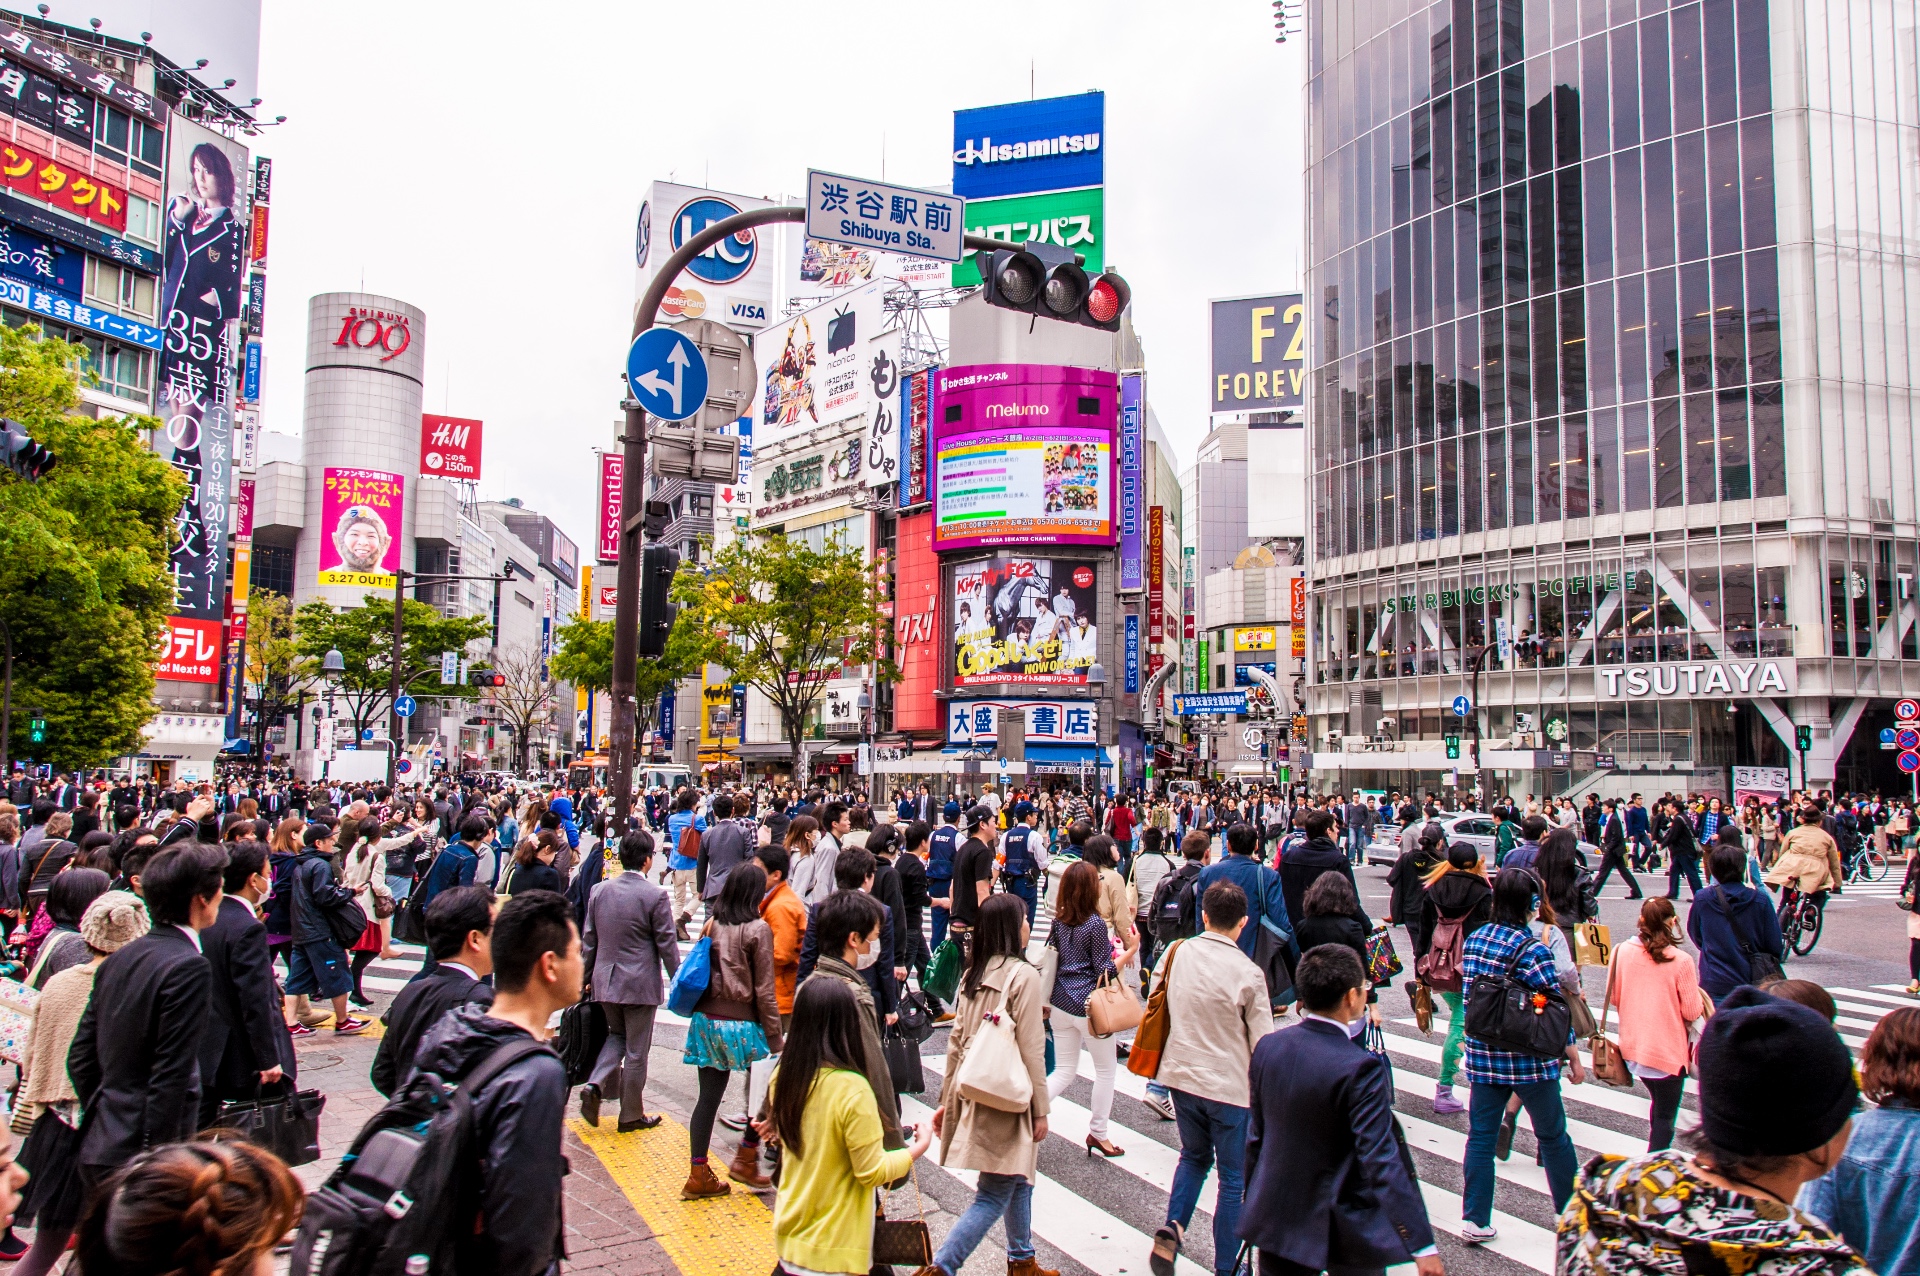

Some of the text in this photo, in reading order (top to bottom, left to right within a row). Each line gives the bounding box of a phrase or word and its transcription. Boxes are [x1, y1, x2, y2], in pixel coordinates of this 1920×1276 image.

[952, 132, 1100, 166] Hisamitsu
[2, 147, 121, 215] ンタクト
[820, 182, 952, 233] 渋谷駅前
[58, 226, 84, 238] JAPANESE
[86, 235, 106, 246] DINING
[840, 219, 936, 250] Shibuya Sta.
[33, 291, 158, 343] 英会話イーオン
[350, 308, 409, 325] SHIBUYA
[731, 303, 766, 320] VISA
[332, 316, 411, 361] 109
[827, 354, 856, 370] niconico
[976, 372, 1009, 383] チャンネル
[869, 349, 897, 480] もんじゃ
[244, 416, 255, 467] 渋谷駅前ビル
[431, 423, 471, 449] H&M
[445, 454, 466, 462] この先
[445, 462, 473, 473] 150m
[1123, 400, 1139, 536] Taisei neon
[326, 477, 401, 496] ラストベスト
[337, 491, 391, 507] アルバム
[601, 456, 622, 558] Essential
[1151, 510, 1162, 585] クスリのことなら
[328, 574, 354, 583] 3.27
[1386, 571, 1637, 614] STARBUCKS COFFEE
[900, 611, 934, 644] クスリ
[1150, 590, 1162, 637] 三千里
[957, 626, 996, 646] NEW ALBUM
[173, 664, 197, 675] Next
[956, 638, 1063, 677] Goodいくぜ!
[1024, 656, 1095, 674] NOW ON SALE!
[1127, 620, 1137, 688] 大盛堂商事ビル
[1601, 662, 1787, 696] TSUTAYA
[954, 706, 1090, 735] 大盛書店
